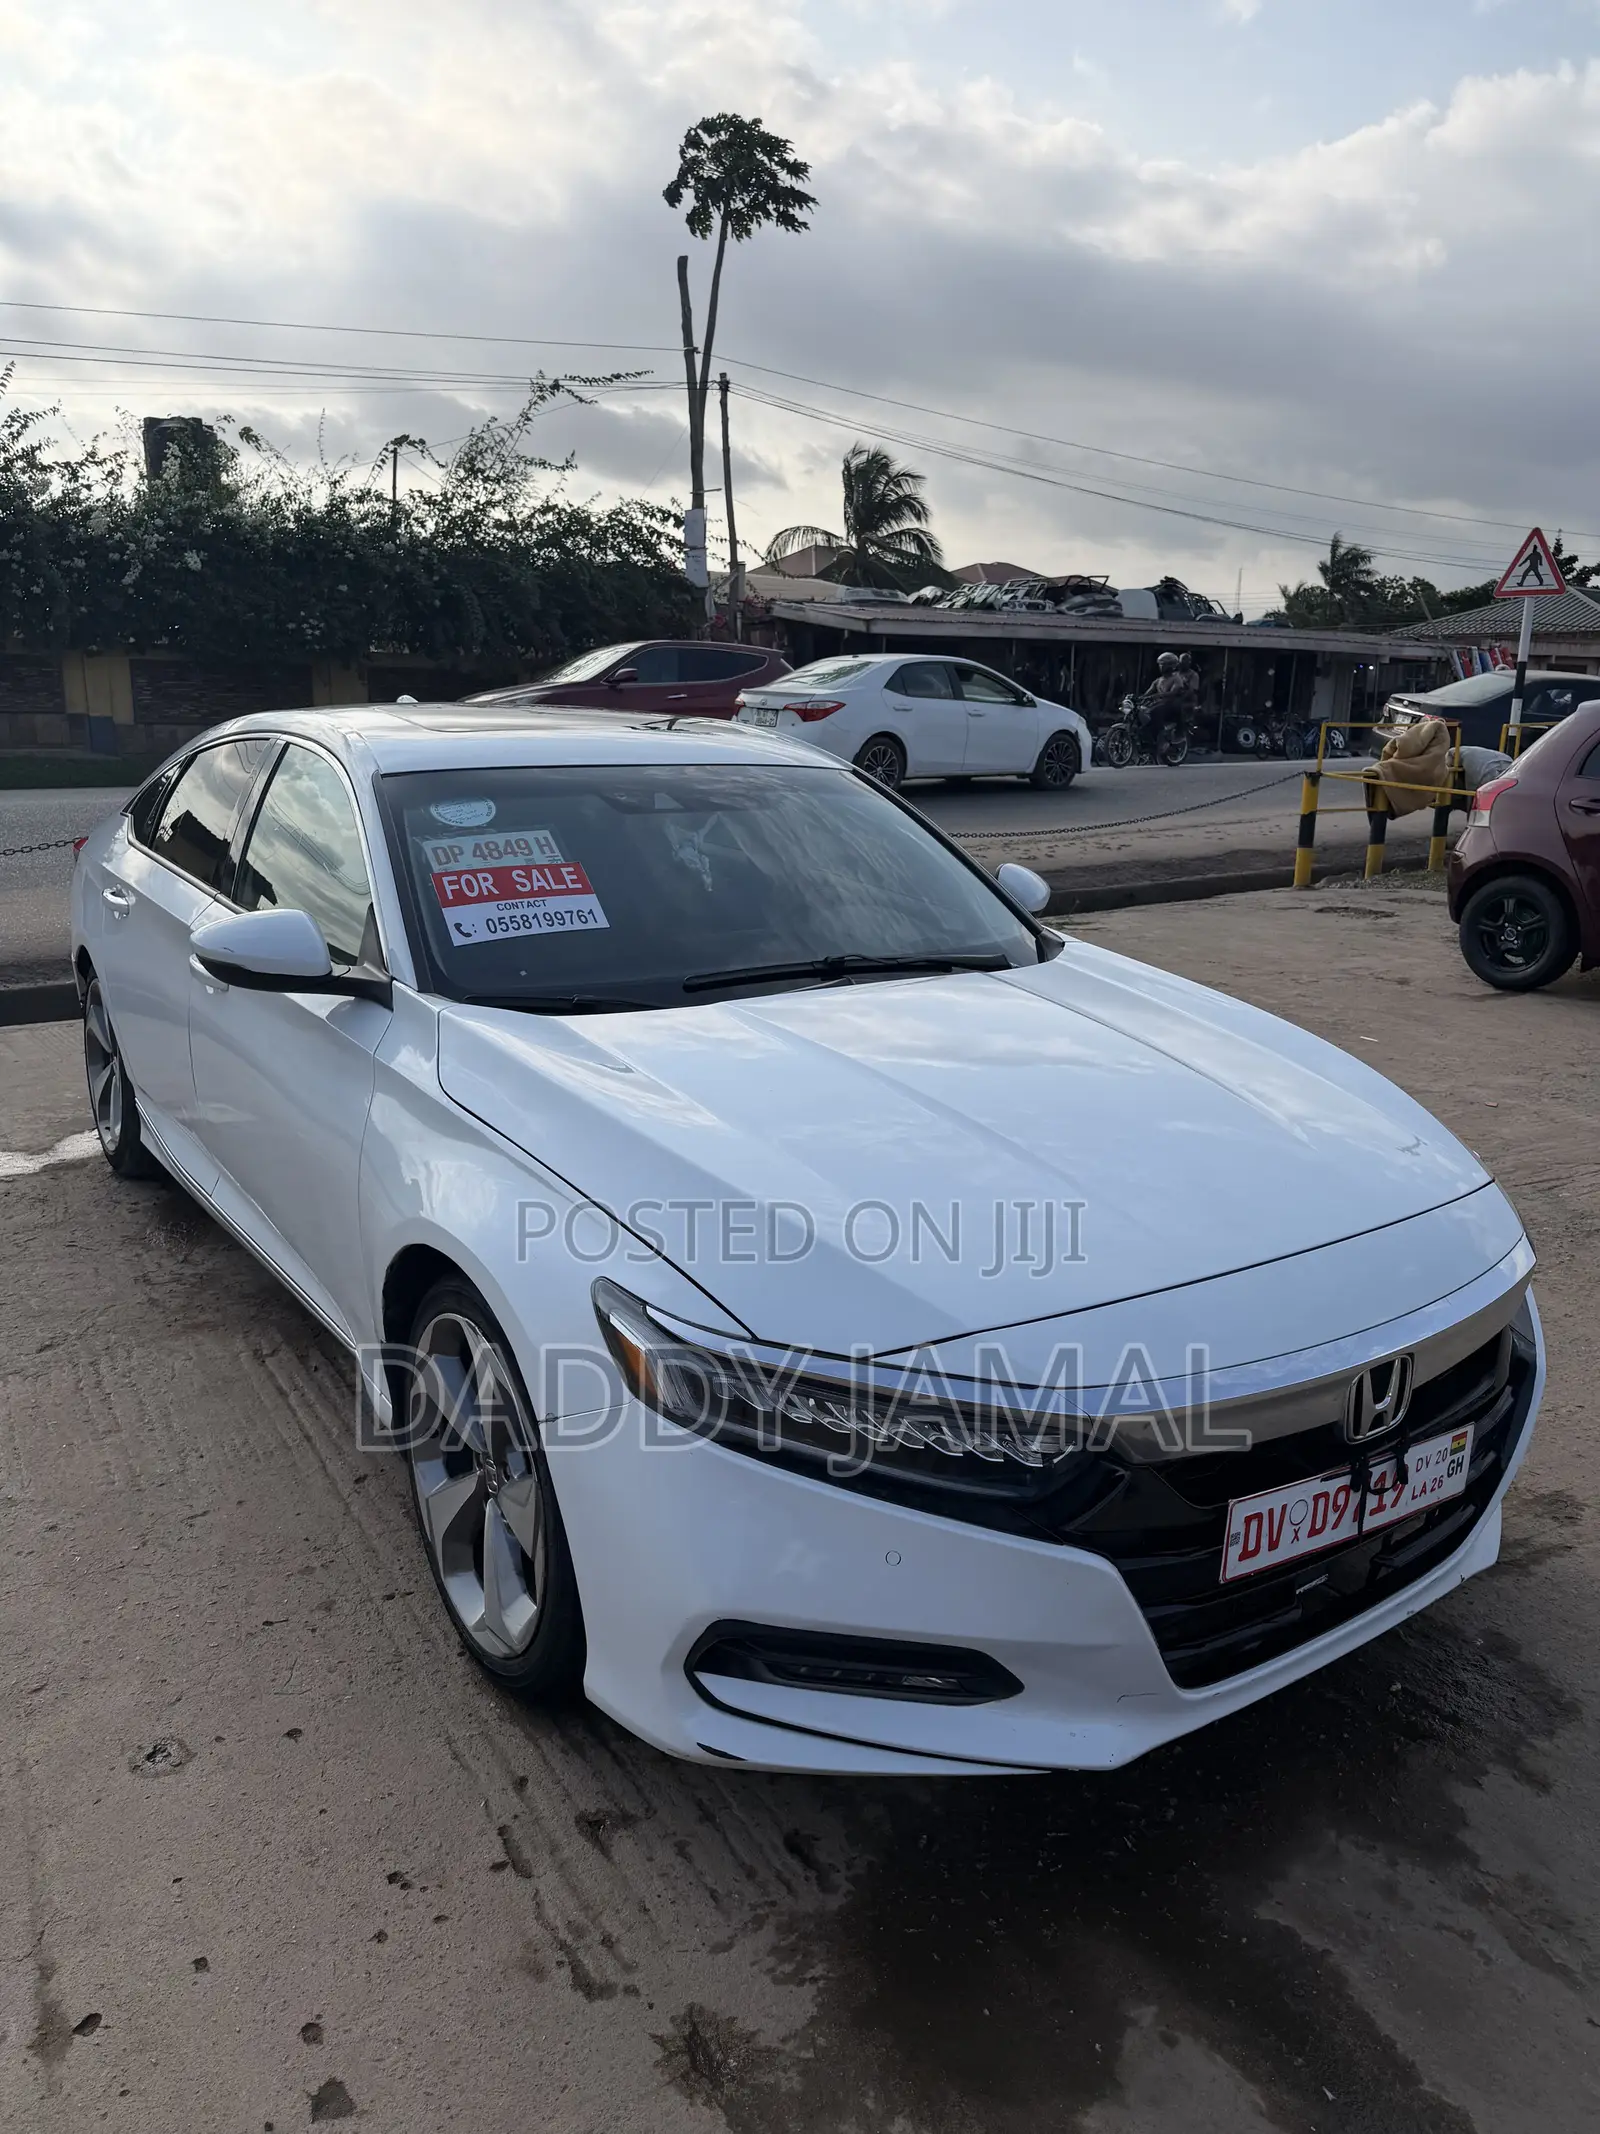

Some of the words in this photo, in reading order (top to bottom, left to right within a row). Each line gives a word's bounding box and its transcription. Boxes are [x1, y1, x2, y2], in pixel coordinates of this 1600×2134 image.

[431, 845, 464, 866] DP
[472, 838, 534, 861] 4849
[533, 836, 556, 855] H
[442, 873, 499, 899] FOR
[511, 867, 582, 892] SALE
[496, 899, 547, 911] CONTACT
[485, 908, 598, 934] 0558199761
[1415, 1453, 1432, 1473] DV
[1435, 1447, 1448, 1465] 20
[1446, 1455, 1464, 1478] GH
[1411, 1480, 1428, 1501] LA
[1430, 1475, 1444, 1493] 26
[1238, 1504, 1288, 1563] DV
